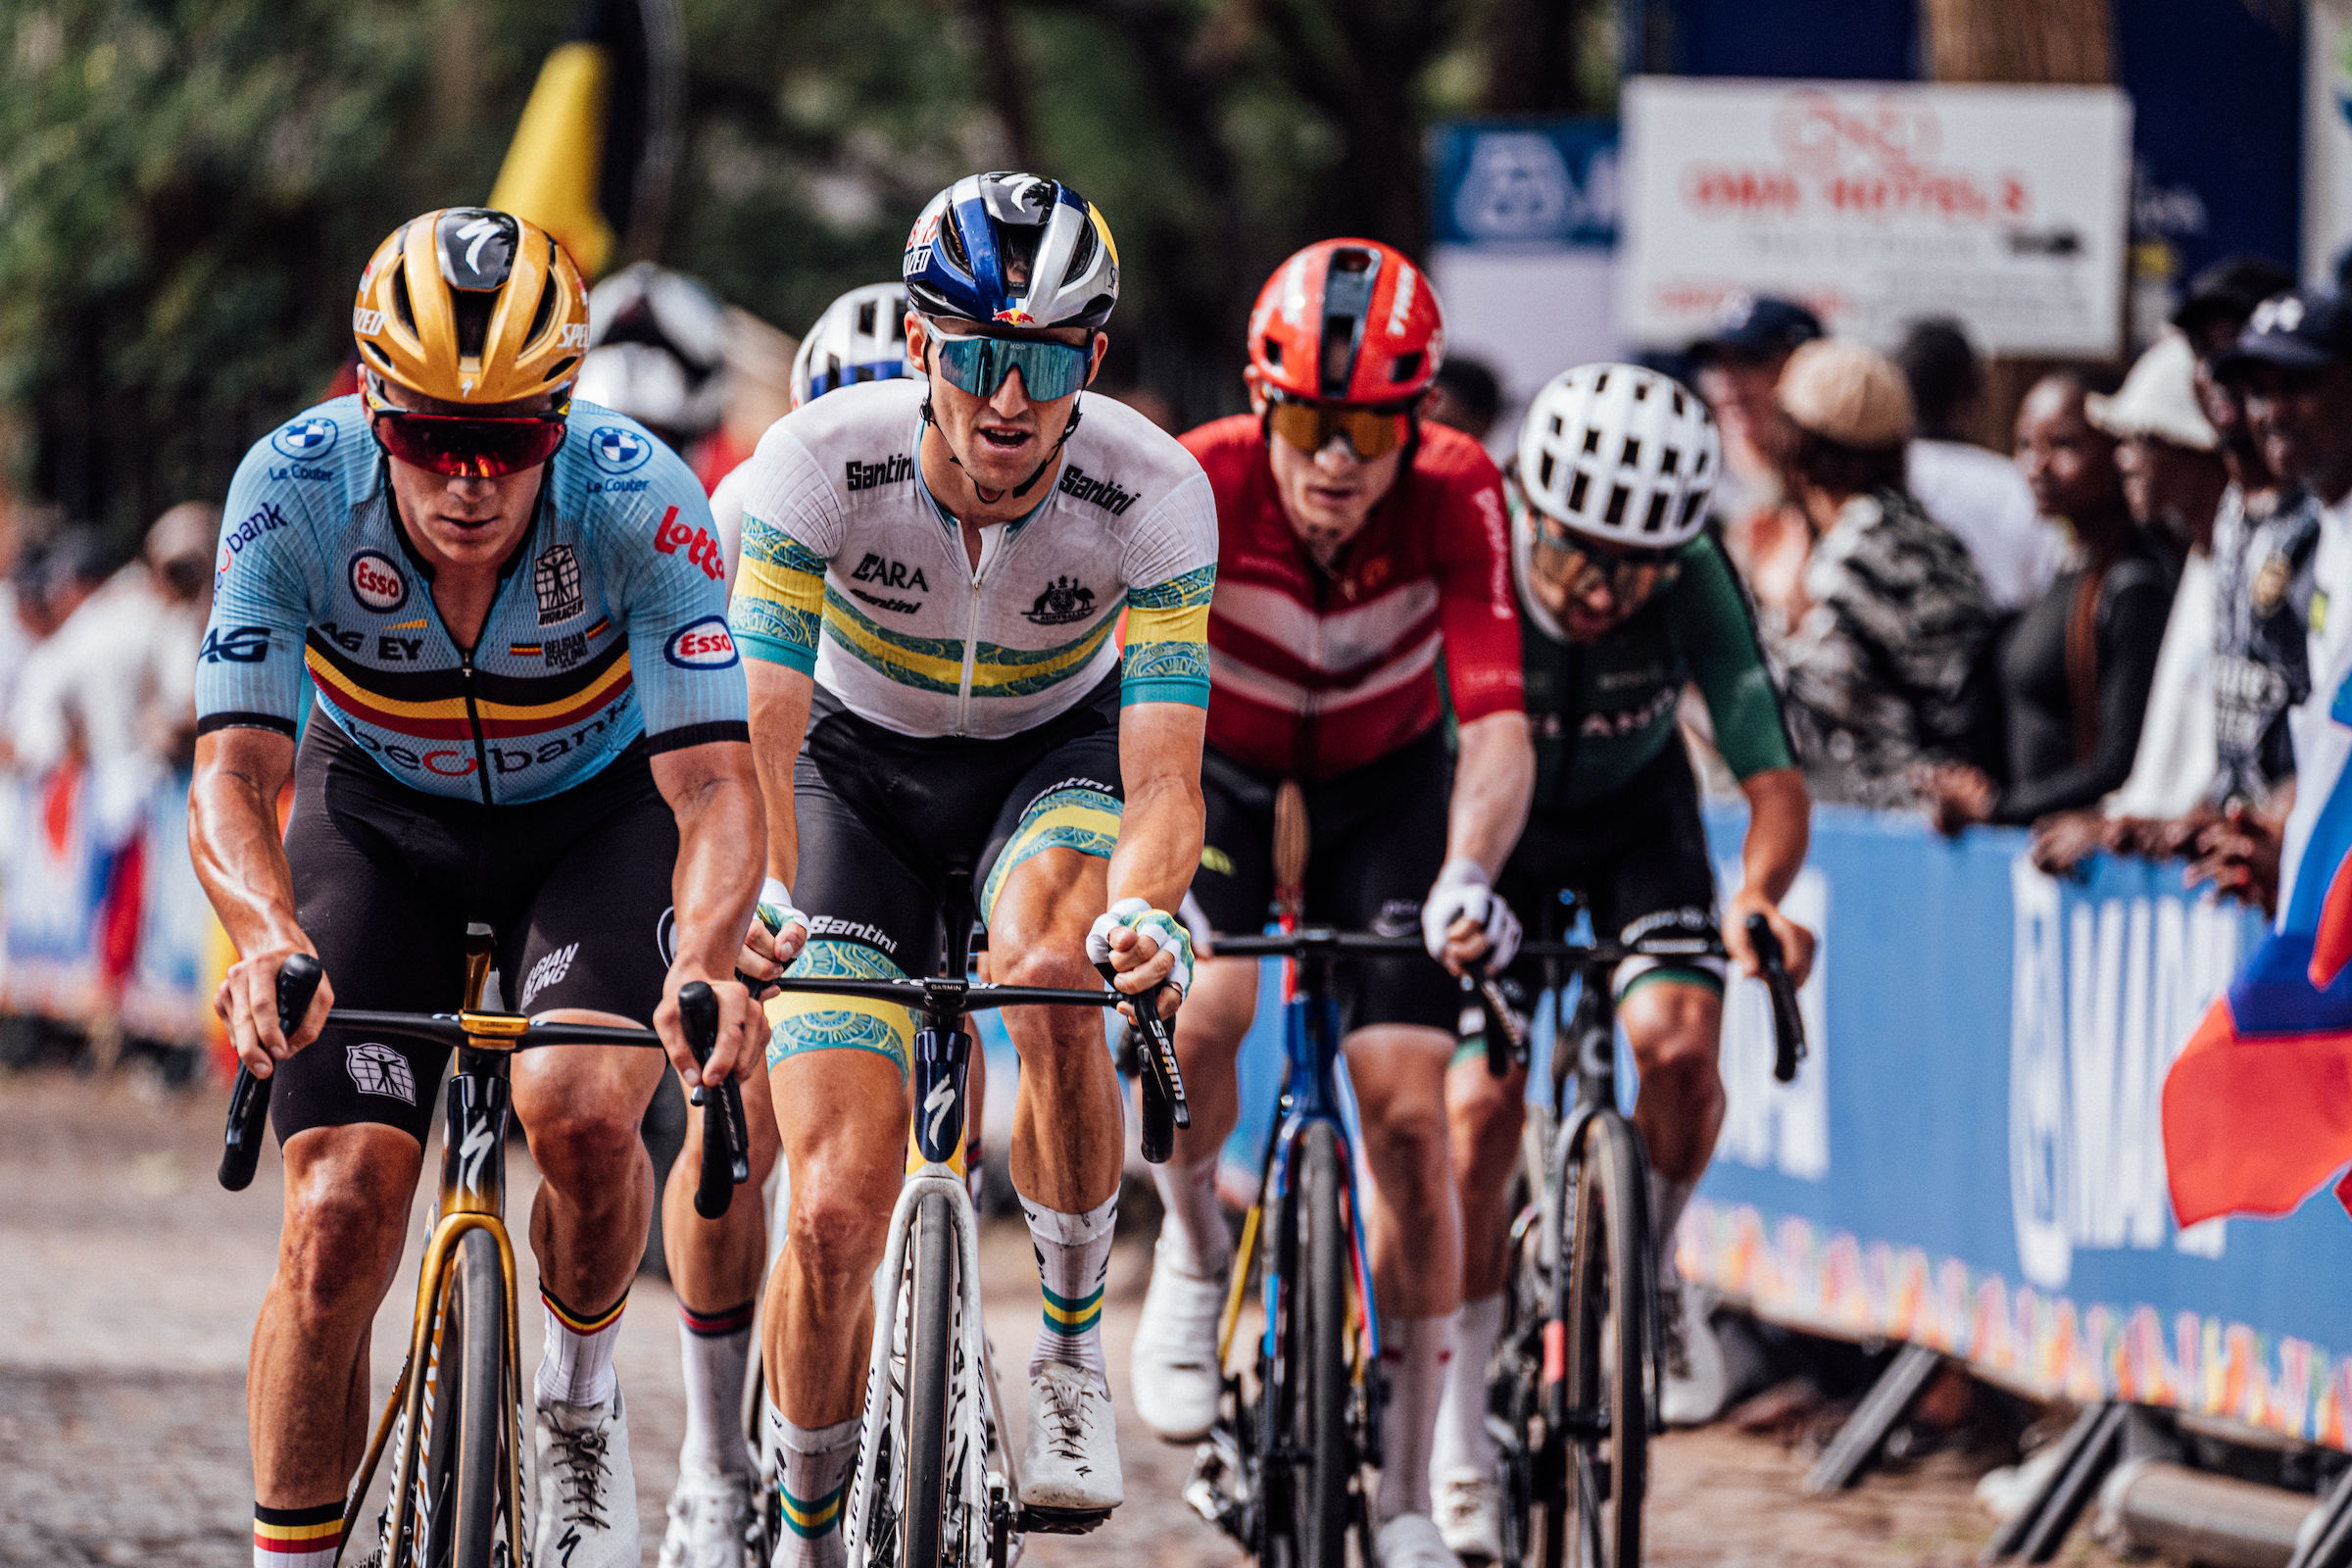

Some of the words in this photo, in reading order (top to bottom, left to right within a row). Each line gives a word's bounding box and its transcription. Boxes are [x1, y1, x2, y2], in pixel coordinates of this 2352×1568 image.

[269, 466, 288, 482] Le
[291, 464, 334, 482] Couter
[605, 477, 650, 493] Couter
[1058, 464, 1142, 516] Santini
[378, 635, 423, 662] EY
[808, 915, 898, 955] Santini
[930, 983, 962, 992] GARMIN
[1149, 1019, 1186, 1101] SRAM
